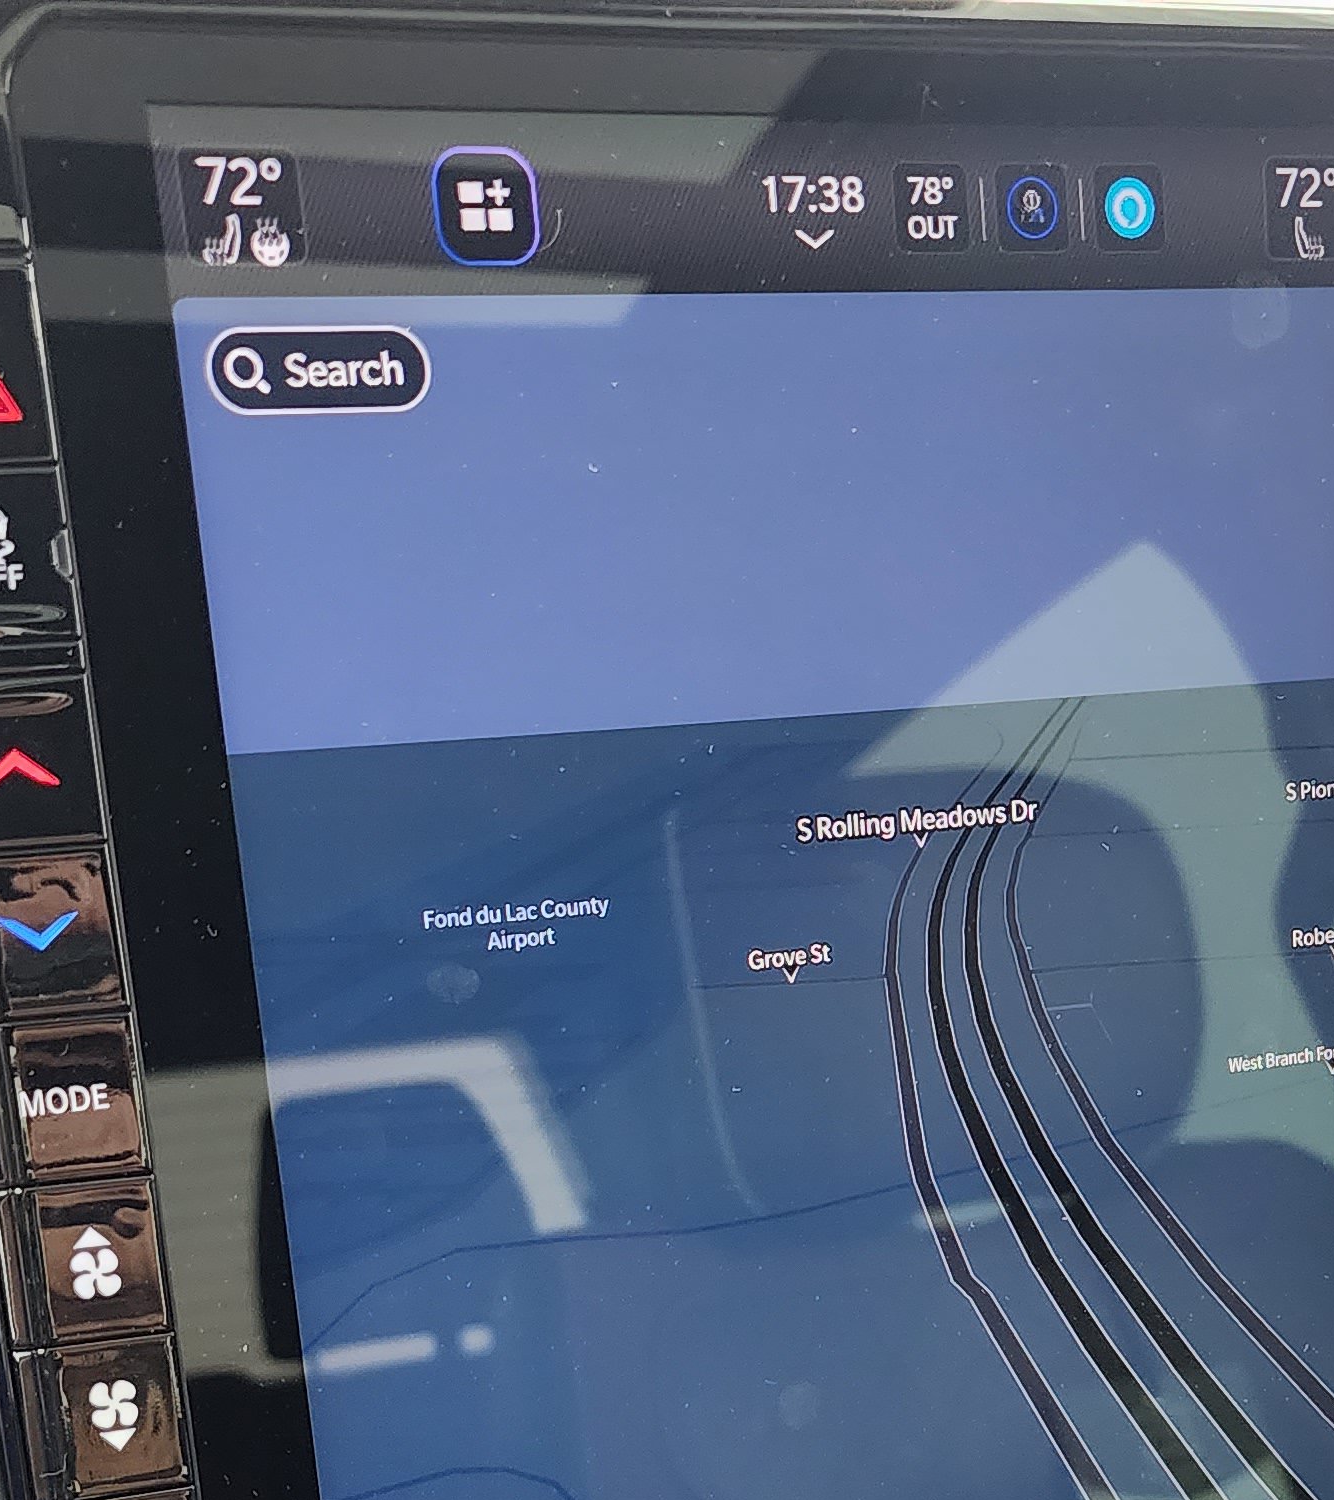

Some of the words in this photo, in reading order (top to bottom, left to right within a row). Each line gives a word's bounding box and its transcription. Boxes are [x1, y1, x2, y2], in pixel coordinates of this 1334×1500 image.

[762, 174, 865, 214] 17:38
[907, 215, 958, 240] OUT
[283, 350, 405, 389] Search
[1285, 782, 1297, 801] S
[796, 817, 812, 843] S
[817, 811, 896, 841] Rolling
[899, 803, 1007, 833] Meadows
[1011, 799, 1038, 823] Dr
[422, 906, 472, 930] Fond
[475, 904, 502, 924] du
[505, 903, 538, 923] Lac
[540, 897, 610, 919] County
[487, 927, 556, 952] Airport
[748, 948, 807, 971] Grove
[810, 942, 832, 964] St
[1227, 1055, 1264, 1074] West
[1265, 1047, 1314, 1069] Branch
[18, 1083, 110, 1119] MODE
